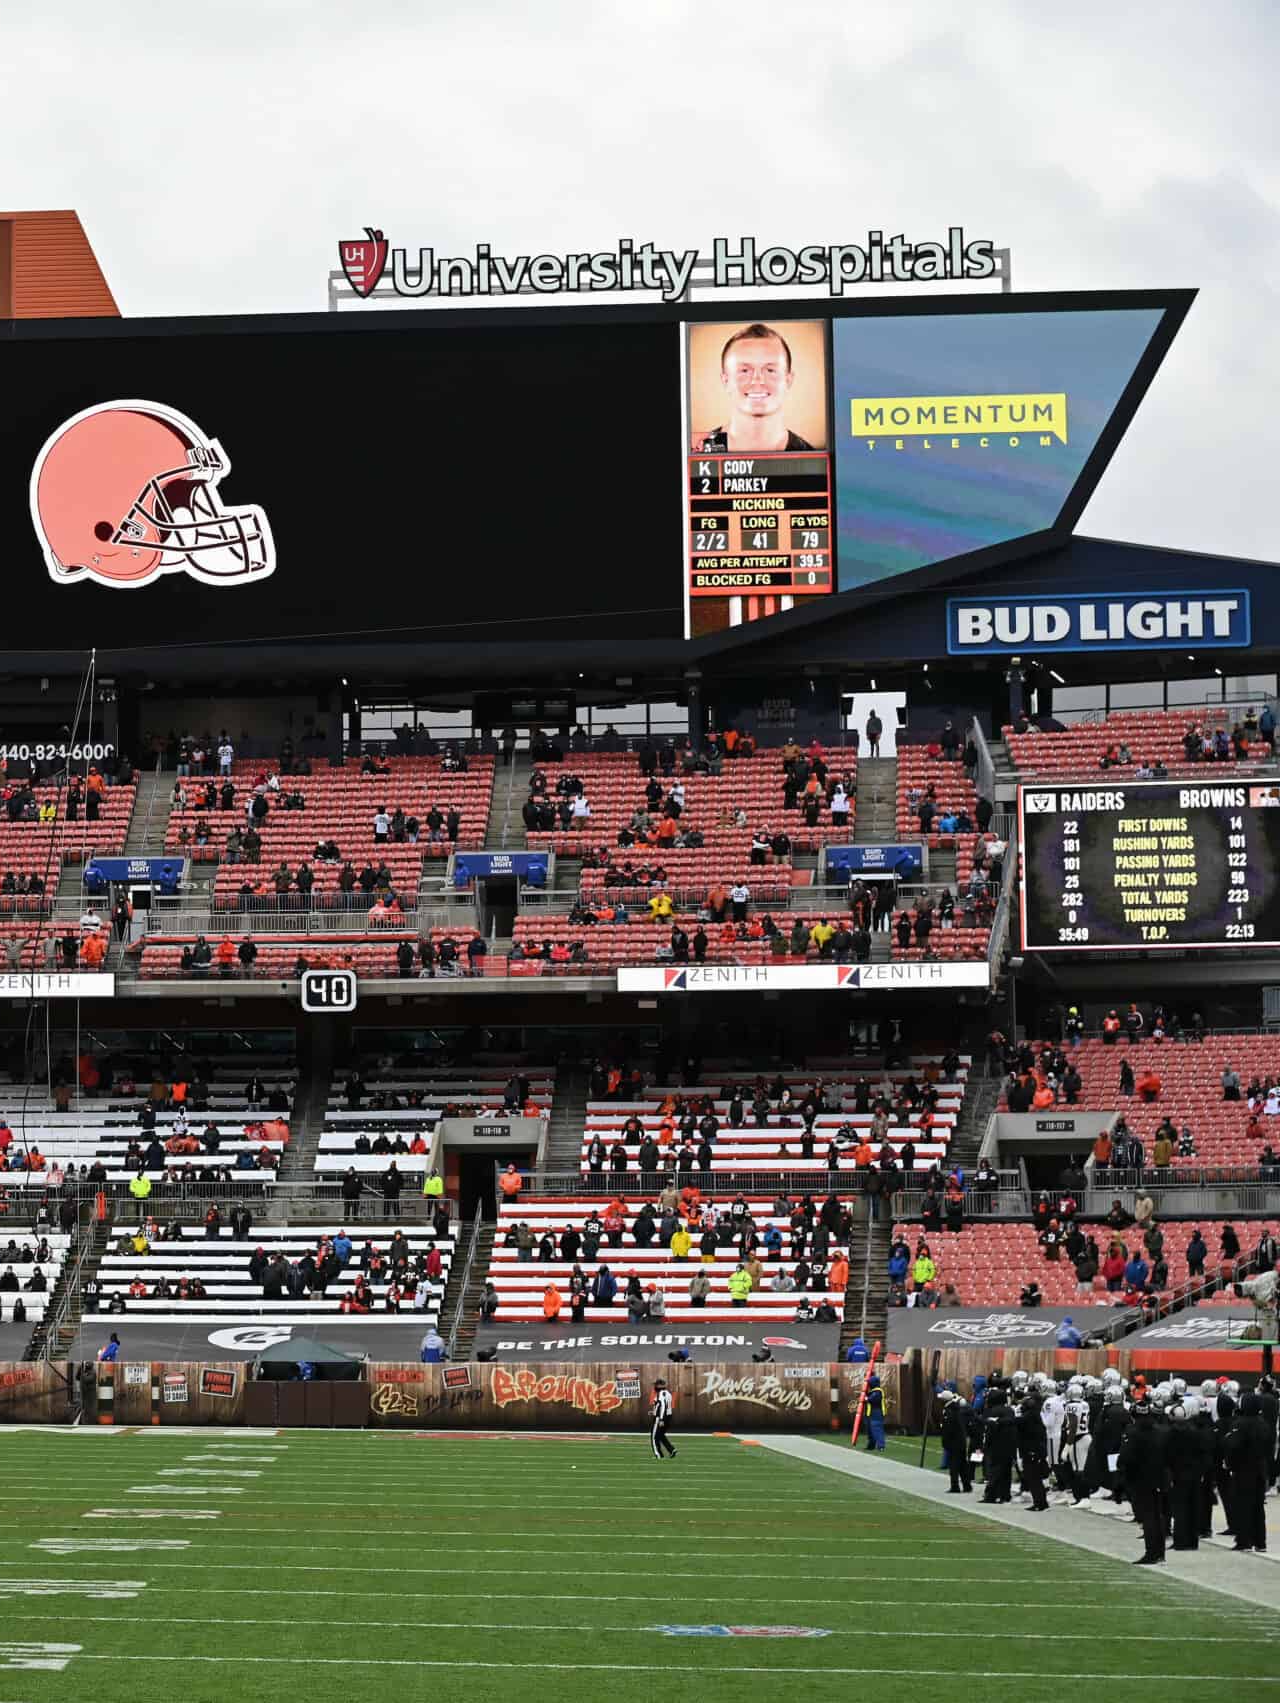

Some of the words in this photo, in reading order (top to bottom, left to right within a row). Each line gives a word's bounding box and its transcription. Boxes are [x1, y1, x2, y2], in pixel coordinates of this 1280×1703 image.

[392, 238, 698, 301] University
[714, 227, 995, 296] Hospitals
[864, 403, 1053, 426] MOMENTUM
[867, 435, 1052, 451] TELECOM
[699, 461, 712, 476] K
[723, 460, 755, 475] CODY
[701, 479, 710, 493] 2
[723, 477, 768, 493] PARKEY
[732, 498, 785, 511] KICKING
[701, 518, 718, 529] FG
[742, 516, 777, 529] LONG
[791, 516, 805, 527] FG
[806, 516, 828, 527] YDS
[696, 533, 726, 550] 2/2
[752, 532, 768, 549] 41
[801, 531, 819, 548] 79
[696, 558, 718, 568] AVG
[720, 557, 741, 567] PER
[742, 556, 788, 568] ATTEMPT
[799, 554, 823, 567] 39.5
[696, 574, 752, 586] BLOCKED
[755, 574, 771, 585] FG
[808, 572, 816, 585] 0
[958, 605, 1071, 644] BUD
[1079, 599, 1238, 640] LIGHT
[1060, 792, 1125, 811] RAIDERS
[1179, 788, 1246, 809] BROWNS
[1063, 821, 1078, 835] 22
[1118, 818, 1148, 833] FIRST
[1149, 817, 1187, 832] DOWNS
[1230, 816, 1243, 830] 14
[1112, 836, 1159, 851] RUSHING
[1161, 835, 1195, 850] YARDS
[1228, 834, 1246, 848] 101
[1062, 856, 1080, 871] 101
[1115, 855, 1160, 870] PASSING
[1161, 854, 1196, 868] YARDS
[1227, 852, 1247, 866] 122
[1064, 874, 1080, 889] 25
[1114, 873, 1160, 888] PENALTY
[1163, 872, 1198, 887] YARDS
[1061, 892, 1084, 907] 282
[1121, 891, 1152, 906] TOTAL
[1154, 889, 1189, 905] YARDS
[1227, 889, 1249, 903] 223
[1068, 910, 1077, 924] 0
[1124, 908, 1186, 923] TURNOVERS
[1236, 907, 1243, 920] 1
[1058, 927, 1089, 942] 35:49
[1141, 926, 1169, 941] T.O.P.
[1225, 924, 1256, 939] 22:13
[689, 967, 768, 982] ZENITH
[863, 965, 943, 980] ZENITH
[311, 977, 348, 1005] 40
[539, 1336, 593, 1350] THE
[600, 1335, 753, 1346] SOLUTION.
[492, 1367, 622, 1415] BROWNS
[698, 1368, 756, 1396] DAWG
[759, 1375, 812, 1411] POUND
